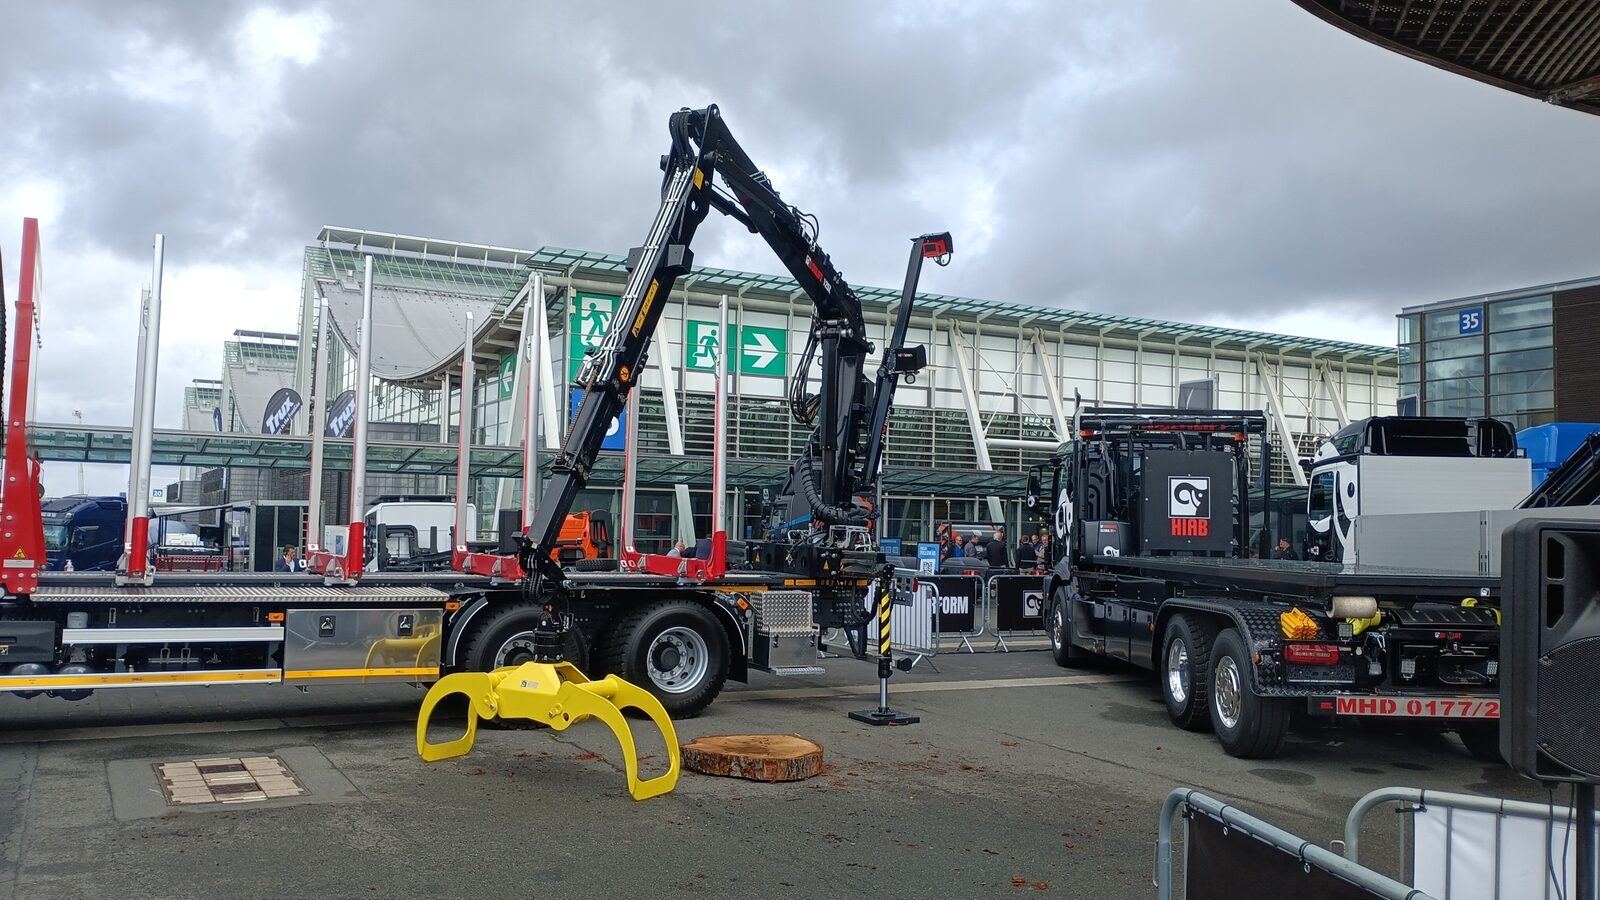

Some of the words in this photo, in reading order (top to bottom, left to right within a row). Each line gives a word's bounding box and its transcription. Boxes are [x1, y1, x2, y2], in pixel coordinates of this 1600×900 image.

[1462, 312, 1479, 330] 35
[265, 396, 295, 435] Trux
[1171, 518, 1208, 537] HIAB
[1337, 698, 1397, 714] MHD
[1407, 699, 1500, 717] 0177/2
